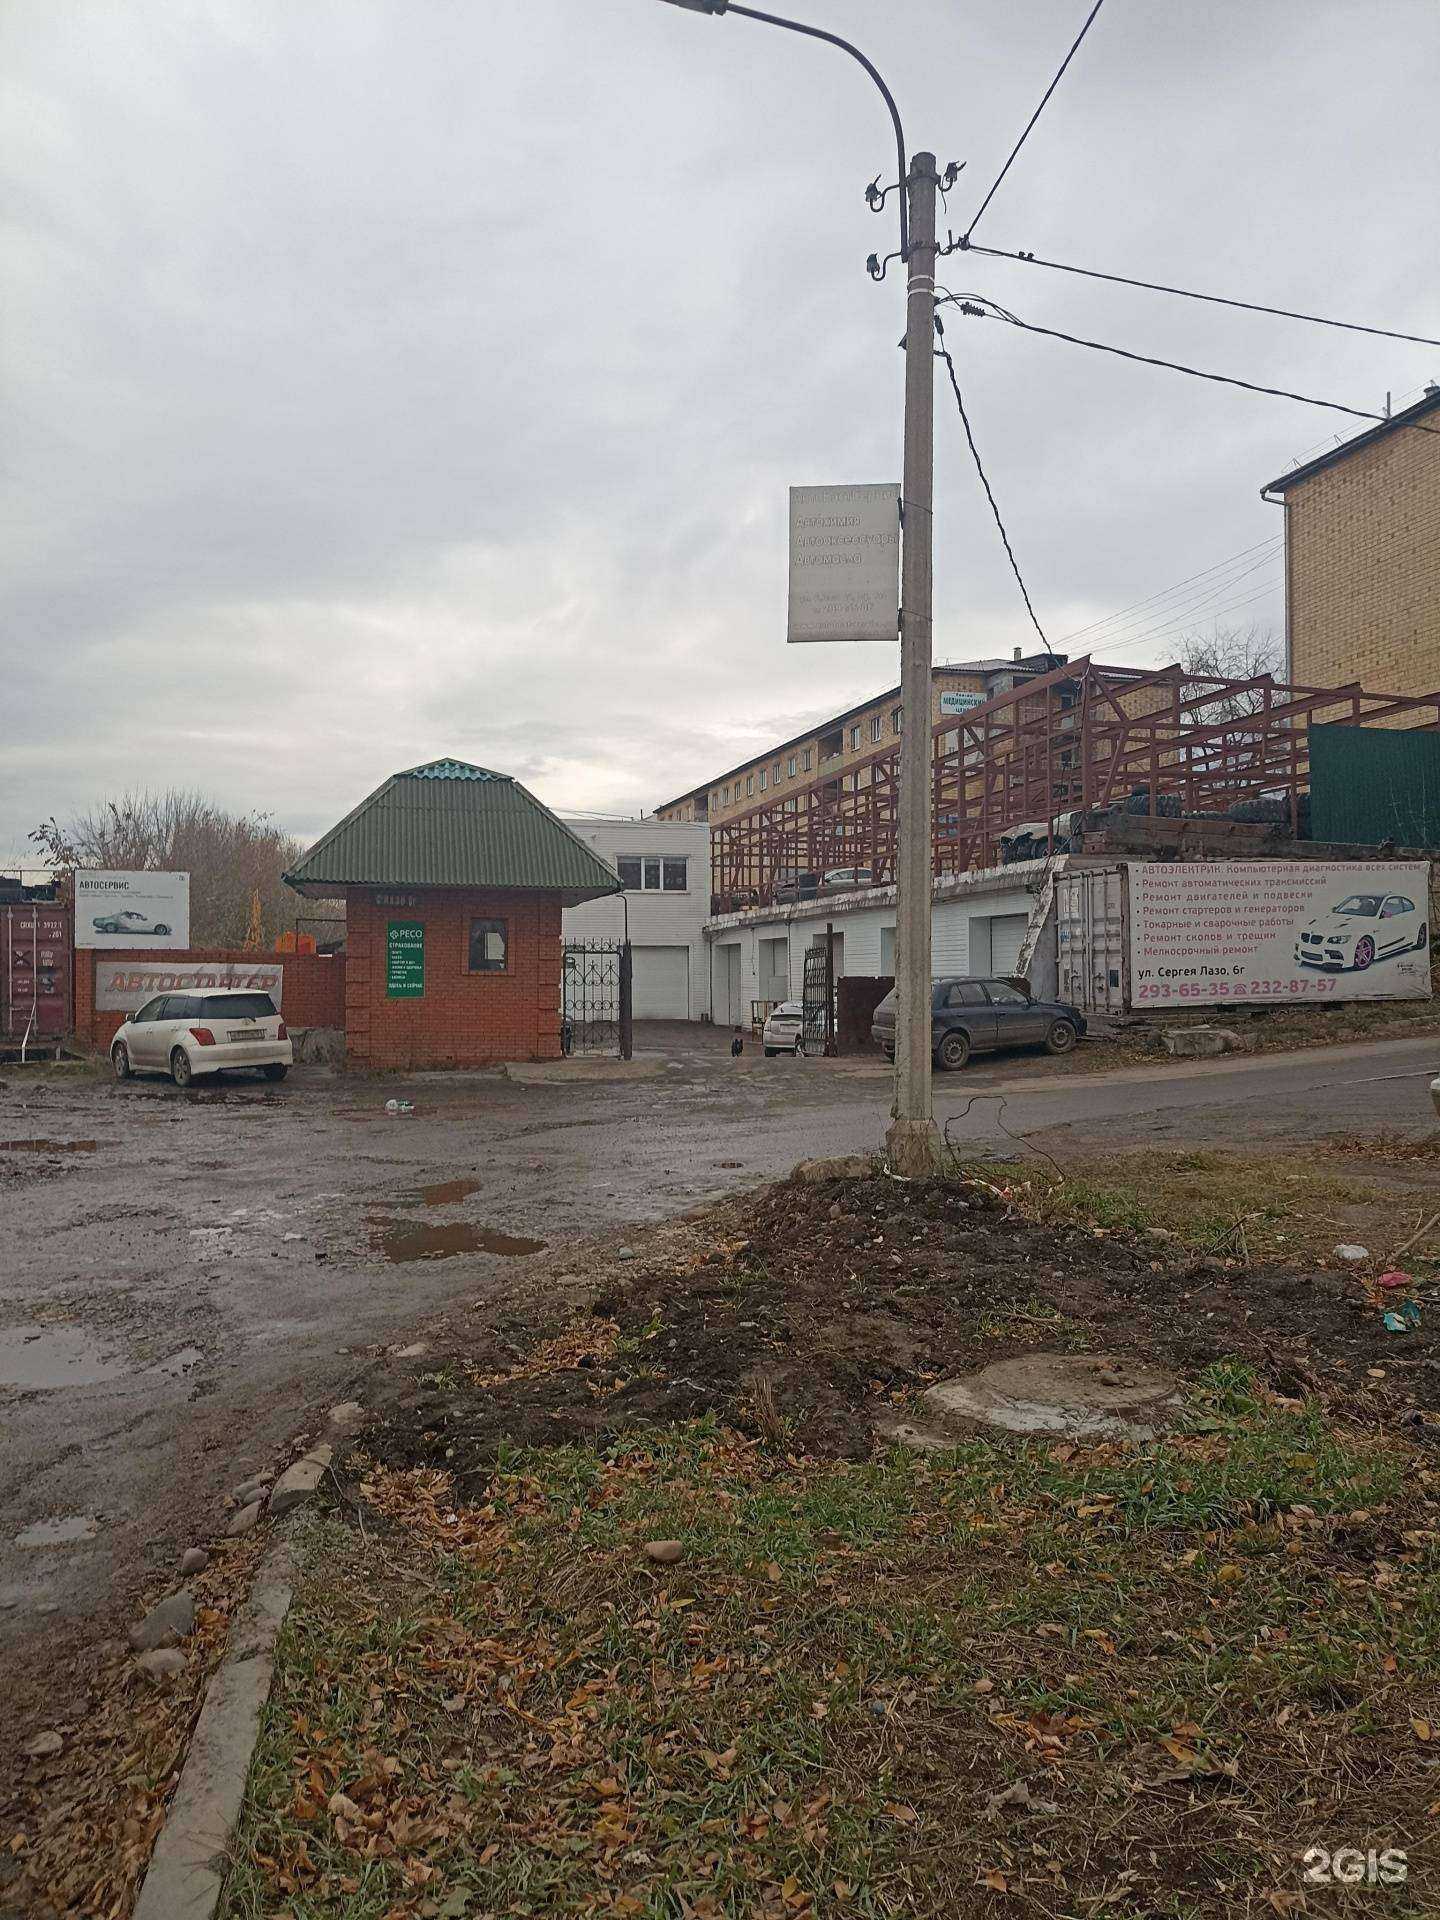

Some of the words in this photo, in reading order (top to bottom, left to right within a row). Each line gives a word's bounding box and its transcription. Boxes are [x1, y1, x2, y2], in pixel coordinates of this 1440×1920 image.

[1226, 864, 1300, 875] Компьютерная
[1303, 864, 1362, 873] диагностика
[1365, 864, 1385, 872] всех
[1389, 863, 1420, 871] систем
[79, 880, 130, 890] АВТОСЕРВИС
[1142, 879, 1179, 888] Ремонт
[1182, 878, 1261, 888] автоматических
[1265, 875, 1327, 887] трансмиссий
[1142, 892, 1181, 901] Ремонт
[1186, 891, 1248, 902] двигателей
[1264, 891, 1313, 900] подвески
[1143, 906, 1179, 915] Ремонт
[1182, 906, 1232, 916] стартеров
[1244, 905, 1305, 914] генераторов
[1144, 920, 1192, 930] Токарные
[1203, 918, 1256, 929] сварочные
[1260, 918, 1294, 928] работы
[400, 929, 423, 938] РЕСО
[1144, 933, 1181, 942] Ремонт
[1186, 932, 1222, 941] сколов
[1237, 932, 1276, 941] трещин
[1222, 945, 1258, 955] ремонт
[1138, 968, 1154, 979] ул.
[1158, 967, 1197, 978] Сергея
[1233, 965, 1246, 975] 6г
[1139, 981, 1230, 999] 293-65-35
[1250, 978, 1337, 995] 232-87-57
